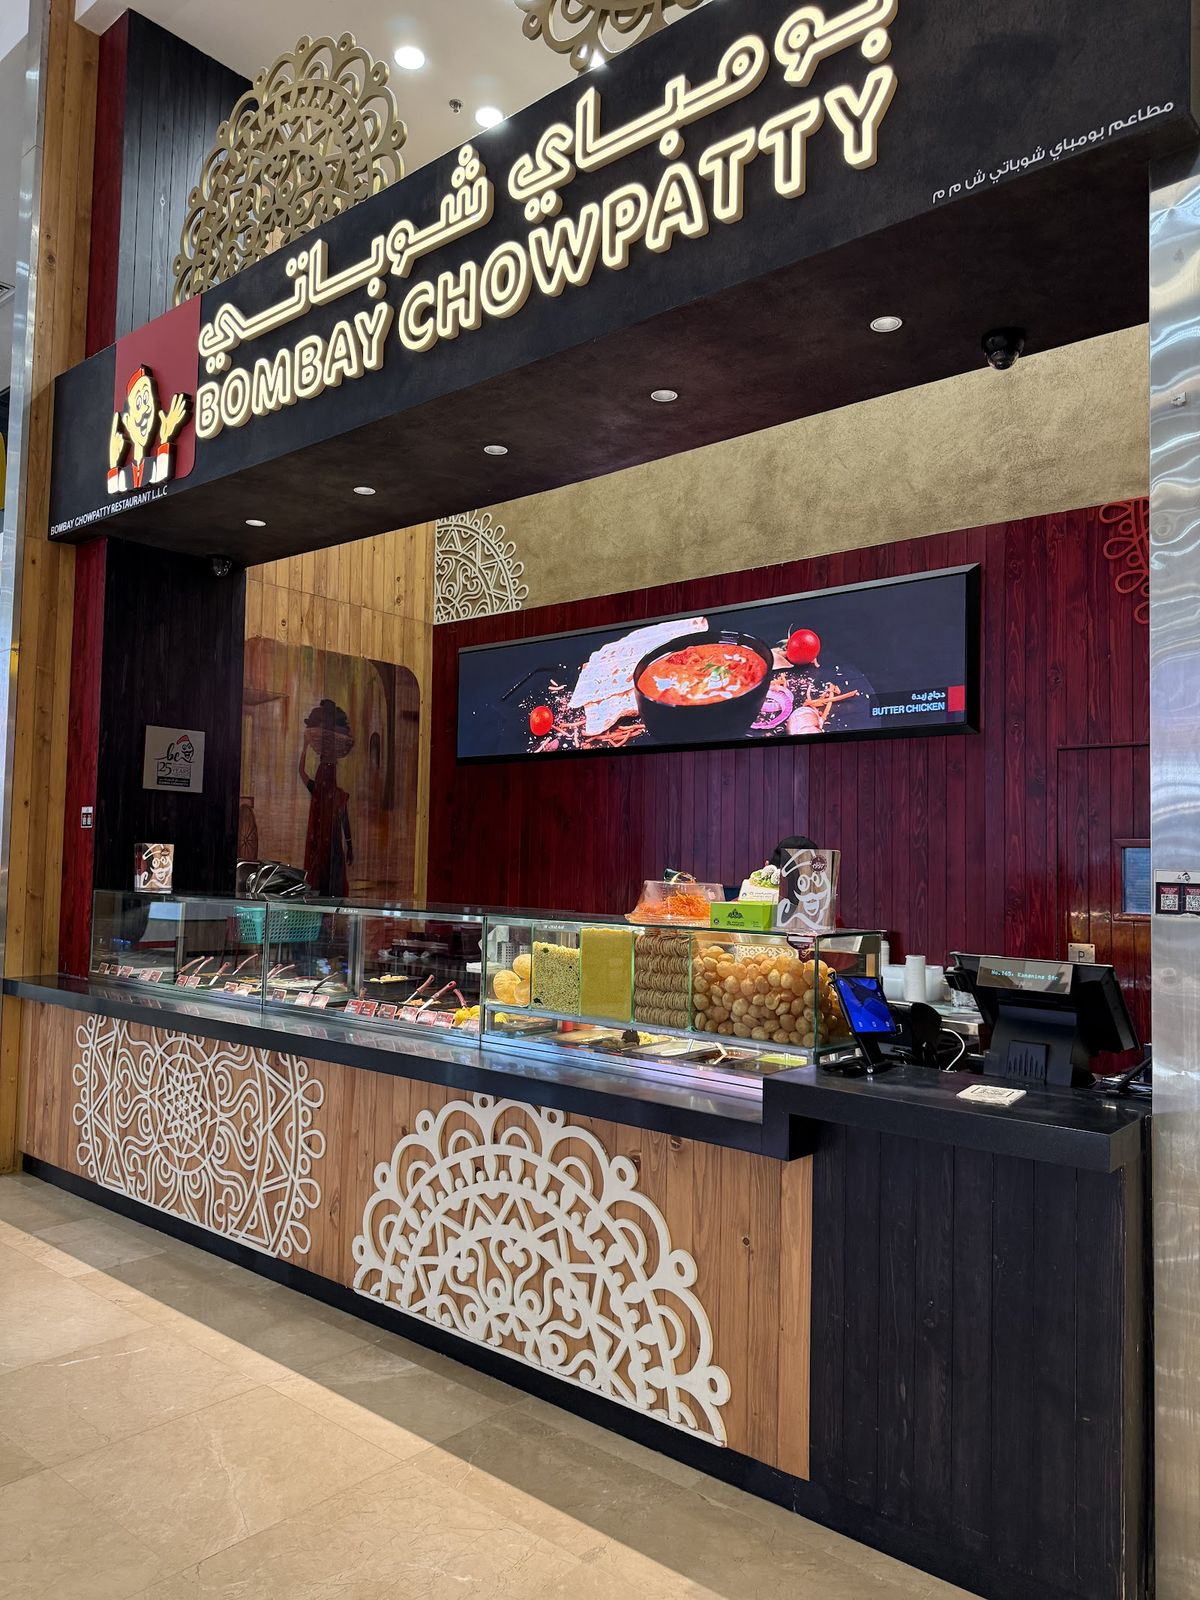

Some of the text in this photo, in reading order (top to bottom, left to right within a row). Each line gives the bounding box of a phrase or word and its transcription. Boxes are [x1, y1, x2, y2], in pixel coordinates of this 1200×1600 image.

[1108, 101, 1174, 136] مطاعم
[1049, 126, 1104, 161] بومباي
[989, 146, 1045, 184] شوباتي
[198, 0, 898, 374] بومباي شوباتي
[195, 65, 898, 439] BOMBAY CHOWPATTY
[50, 485, 168, 535] BOMBAY CHOWPATTY RESTAURANT L.L.C
[872, 701, 946, 716] BUTTER CHICKEN
[911, 690, 946, 701] دجاج زبدة
